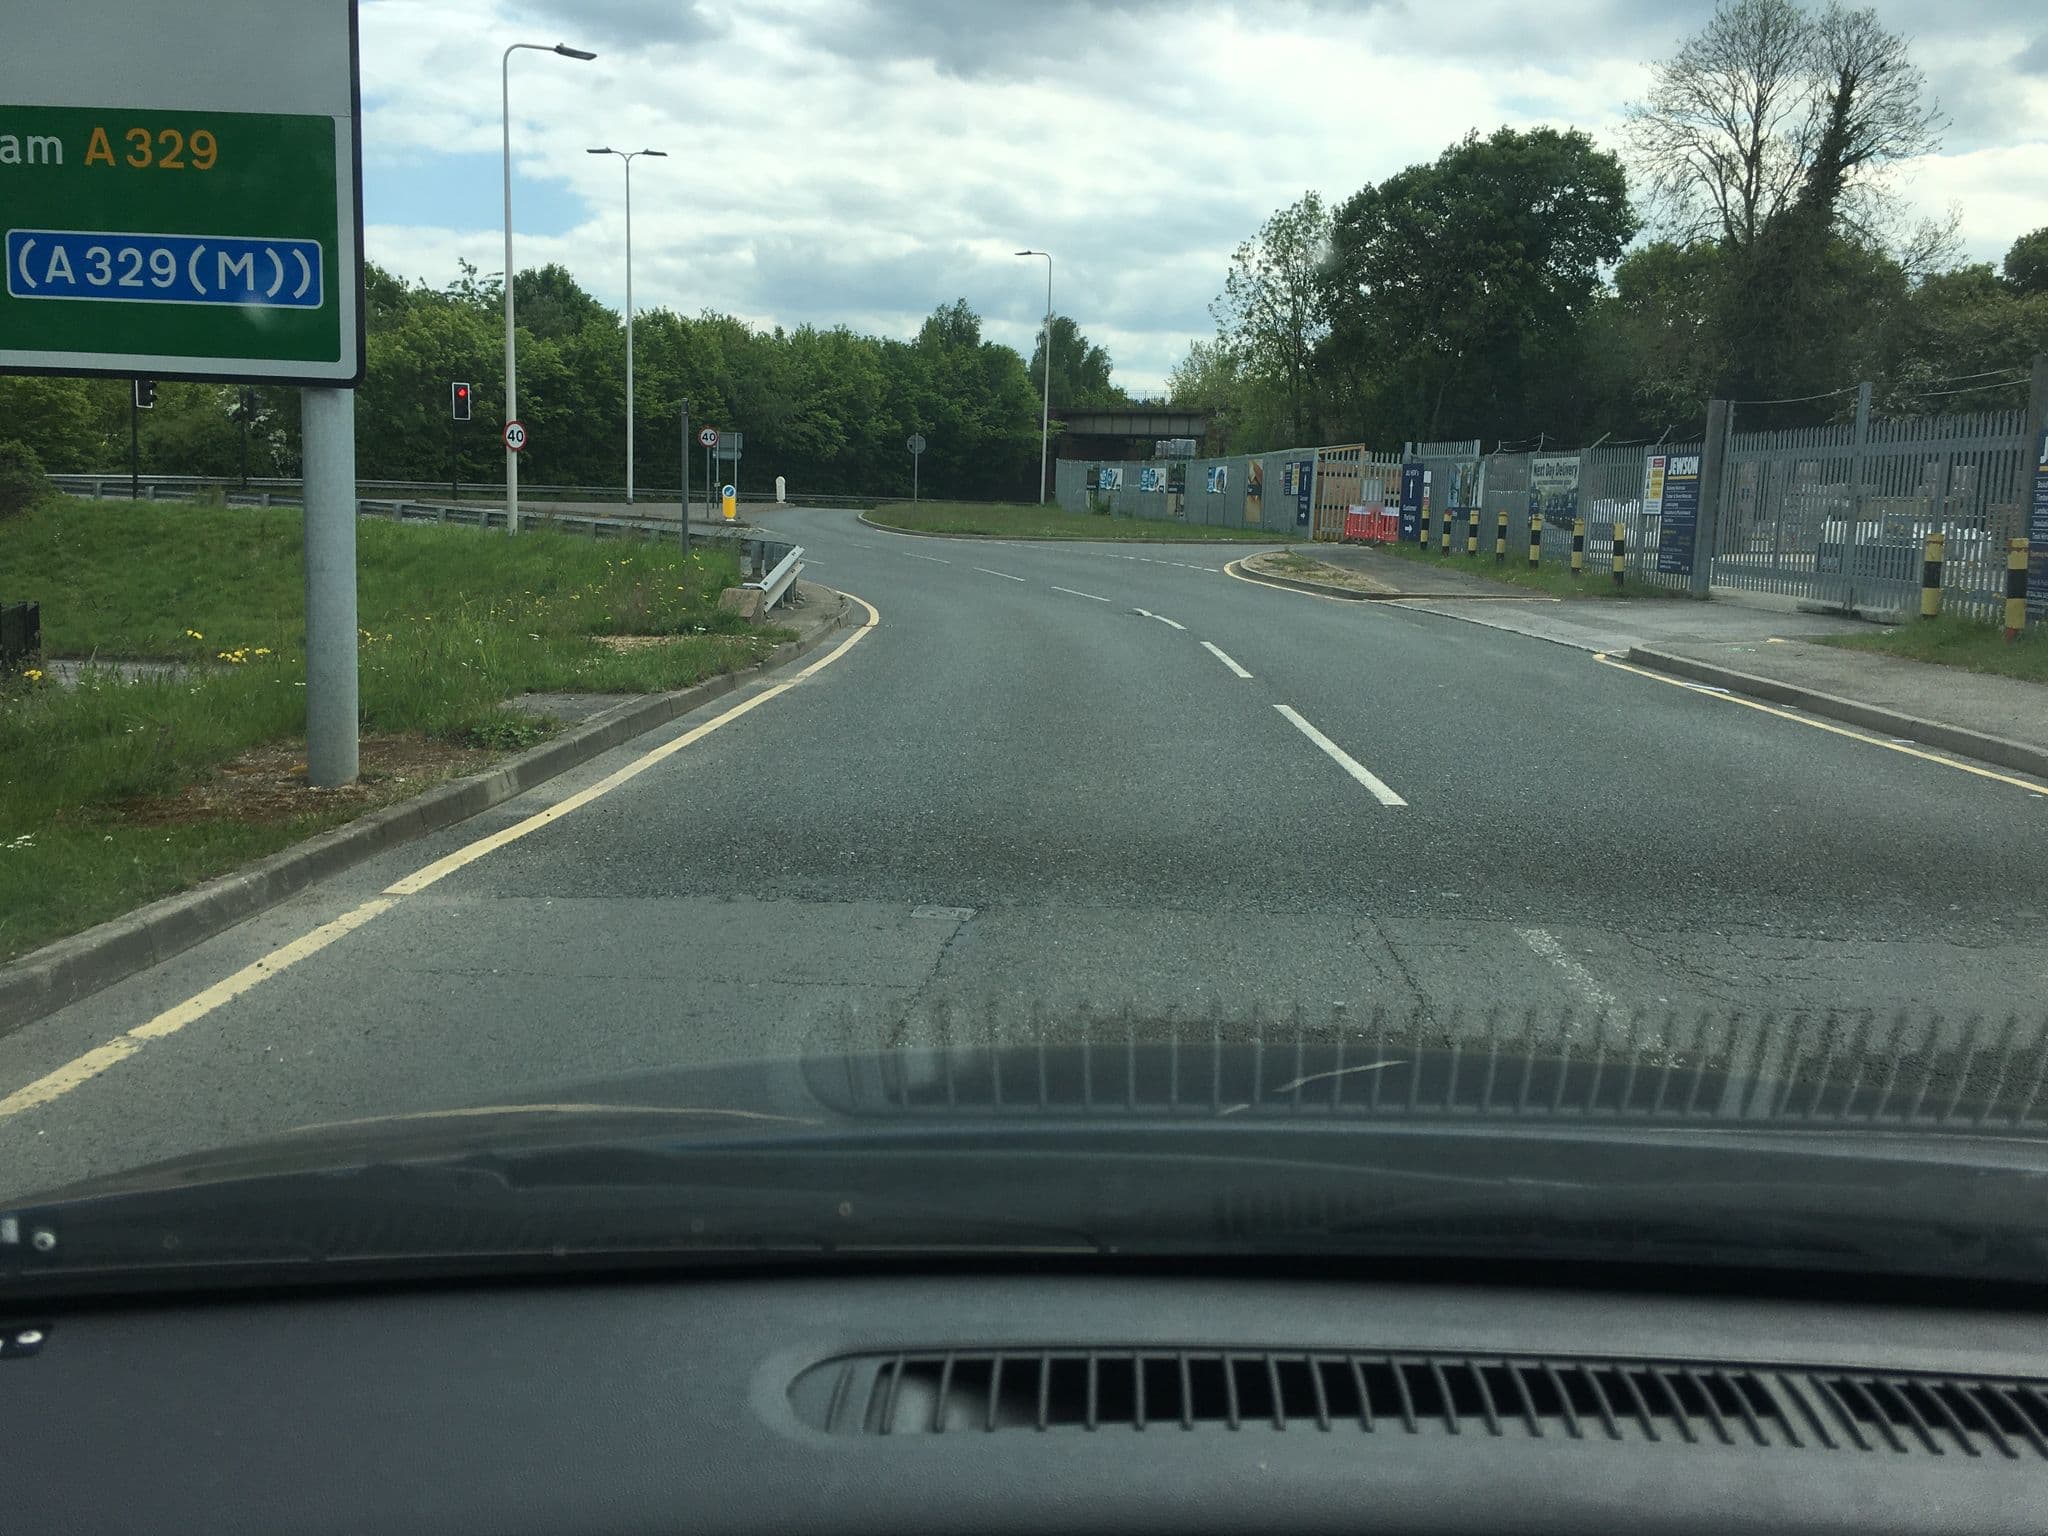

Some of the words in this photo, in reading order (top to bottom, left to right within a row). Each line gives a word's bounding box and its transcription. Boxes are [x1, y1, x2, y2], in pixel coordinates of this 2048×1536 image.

[0, 134, 64, 165] am
[84, 127, 219, 170] A329
[18, 238, 312, 299] (A329(M))
[507, 429, 524, 442] 40
[702, 432, 716, 442] 40
[1533, 463, 1545, 477] Next
[1545, 462, 1555, 479] Day
[1555, 461, 1578, 479] Delivery
[1668, 456, 1699, 475] JEWSON
